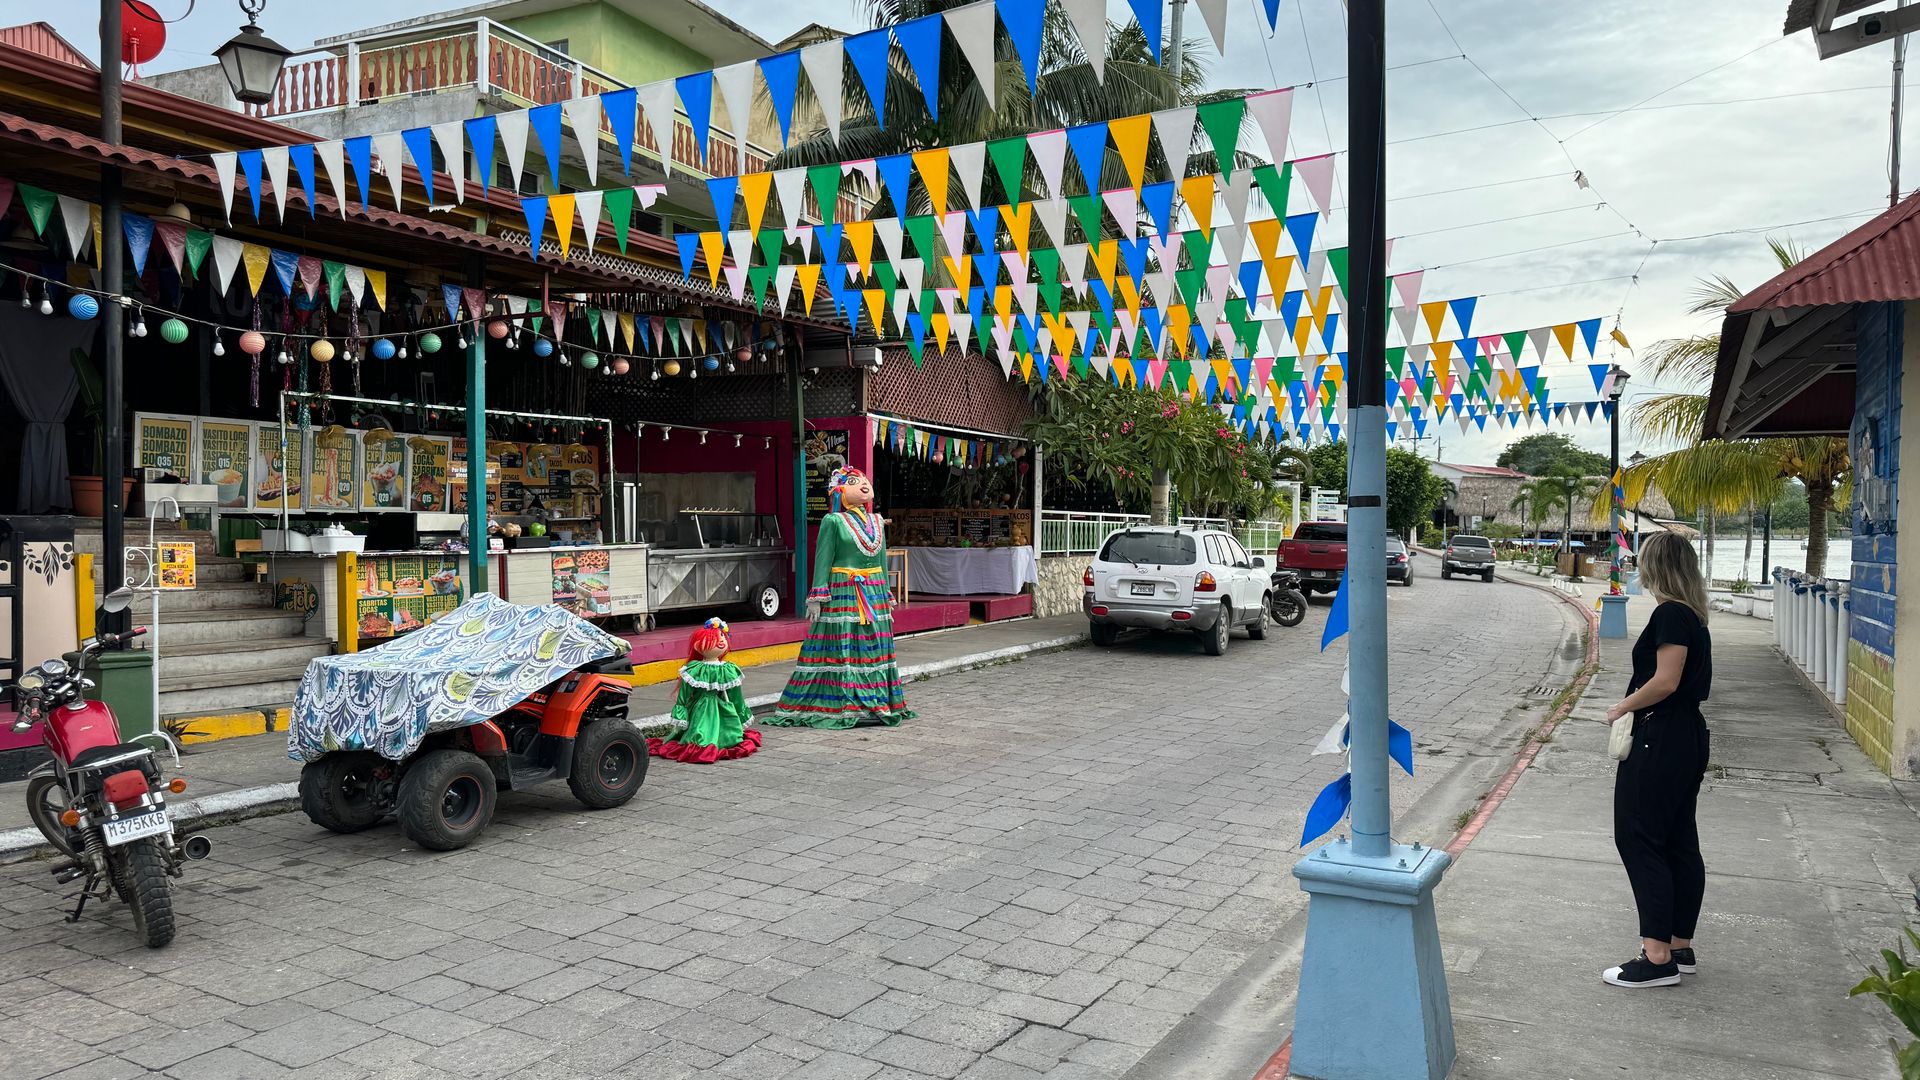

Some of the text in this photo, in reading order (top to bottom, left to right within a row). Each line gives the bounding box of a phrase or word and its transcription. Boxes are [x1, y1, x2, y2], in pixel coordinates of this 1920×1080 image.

[143, 426, 187, 441] BOMBAZO
[203, 429, 248, 442] VASITO LOCO
[142, 439, 187, 454] BOMBAZO
[157, 456, 172, 467] Q35
[218, 458, 231, 468] Q15
[413, 455, 435, 467] LOCAS
[338, 482, 351, 493] Q20
[378, 493, 389, 503] Q20
[422, 494, 432, 504] Q15
[1009, 512, 1030, 520] TACOS
[358, 599, 388, 608] SABRITAS
[358, 607, 379, 615] LOCAS
